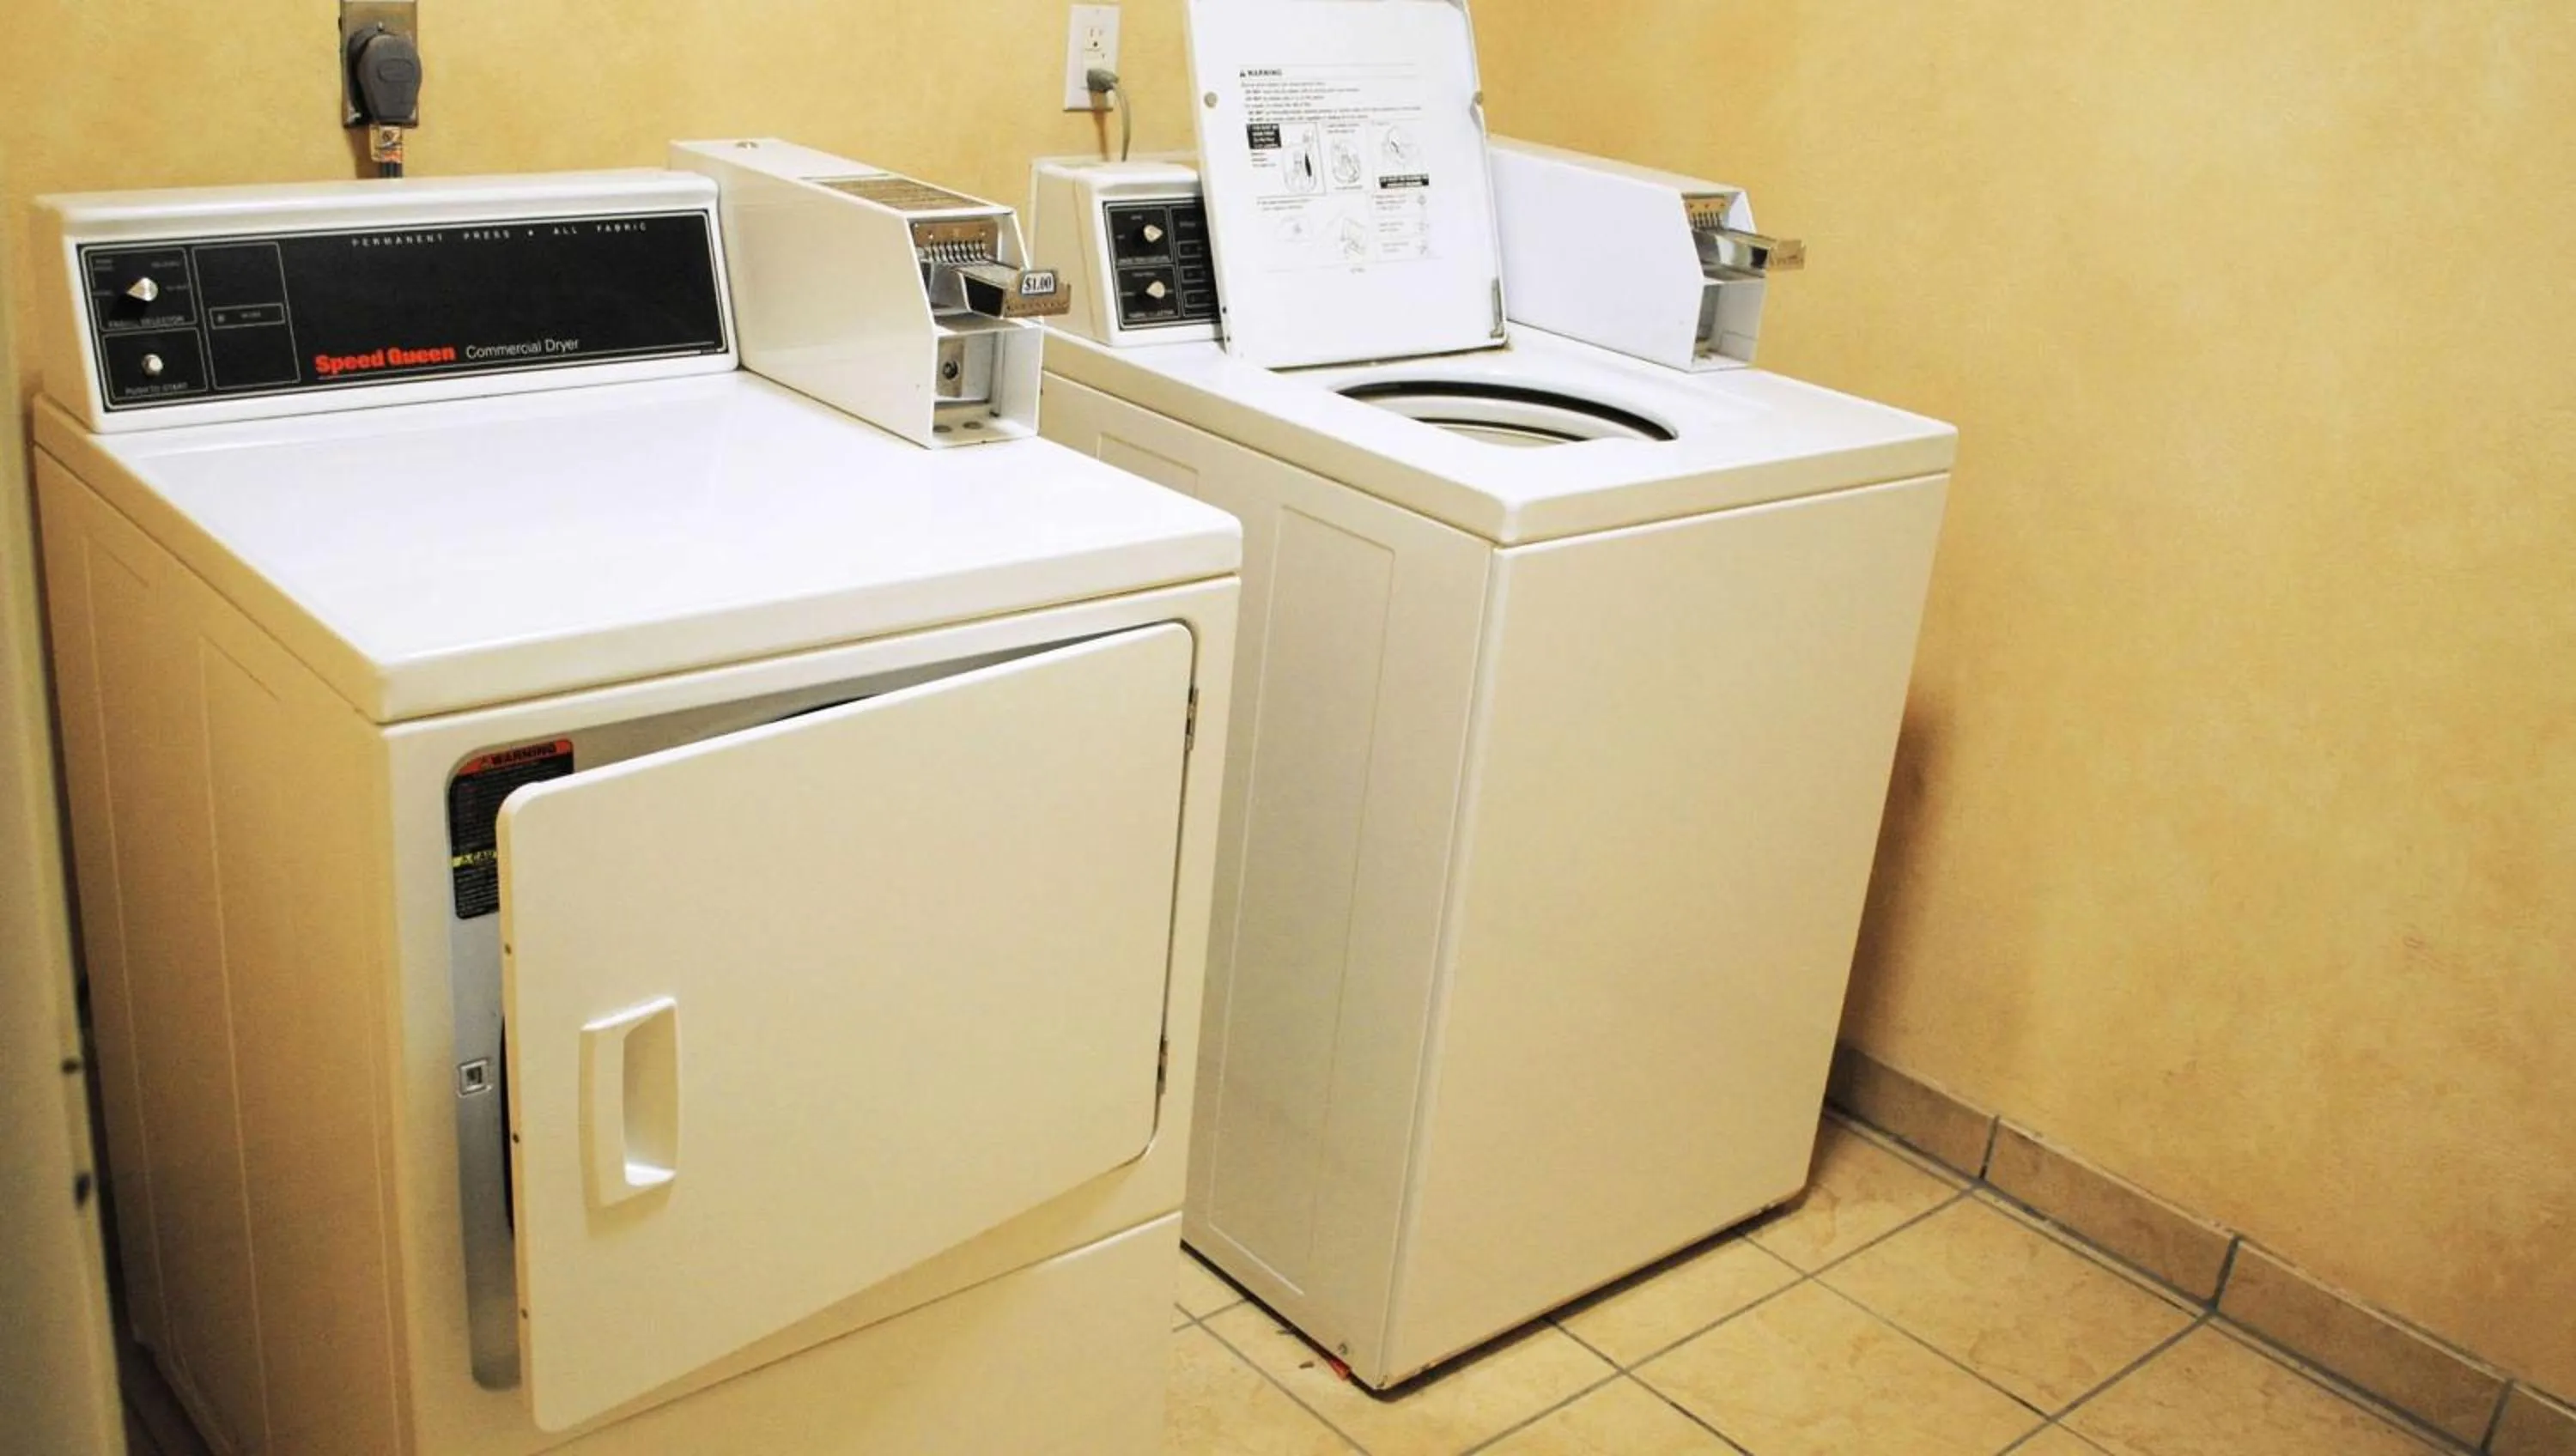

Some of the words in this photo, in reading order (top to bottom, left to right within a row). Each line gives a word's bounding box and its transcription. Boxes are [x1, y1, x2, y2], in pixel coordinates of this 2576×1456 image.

[351, 233, 443, 246] PERMANENT
[463, 229, 510, 240] PRESS
[554, 225, 577, 234] ALL
[597, 221, 646, 232] FABRIC
[1024, 276, 1052, 291] $1.00
[315, 349, 385, 374] Speed
[387, 345, 456, 366] Queen
[465, 340, 542, 359] Commercial
[544, 338, 579, 355] Dryer
